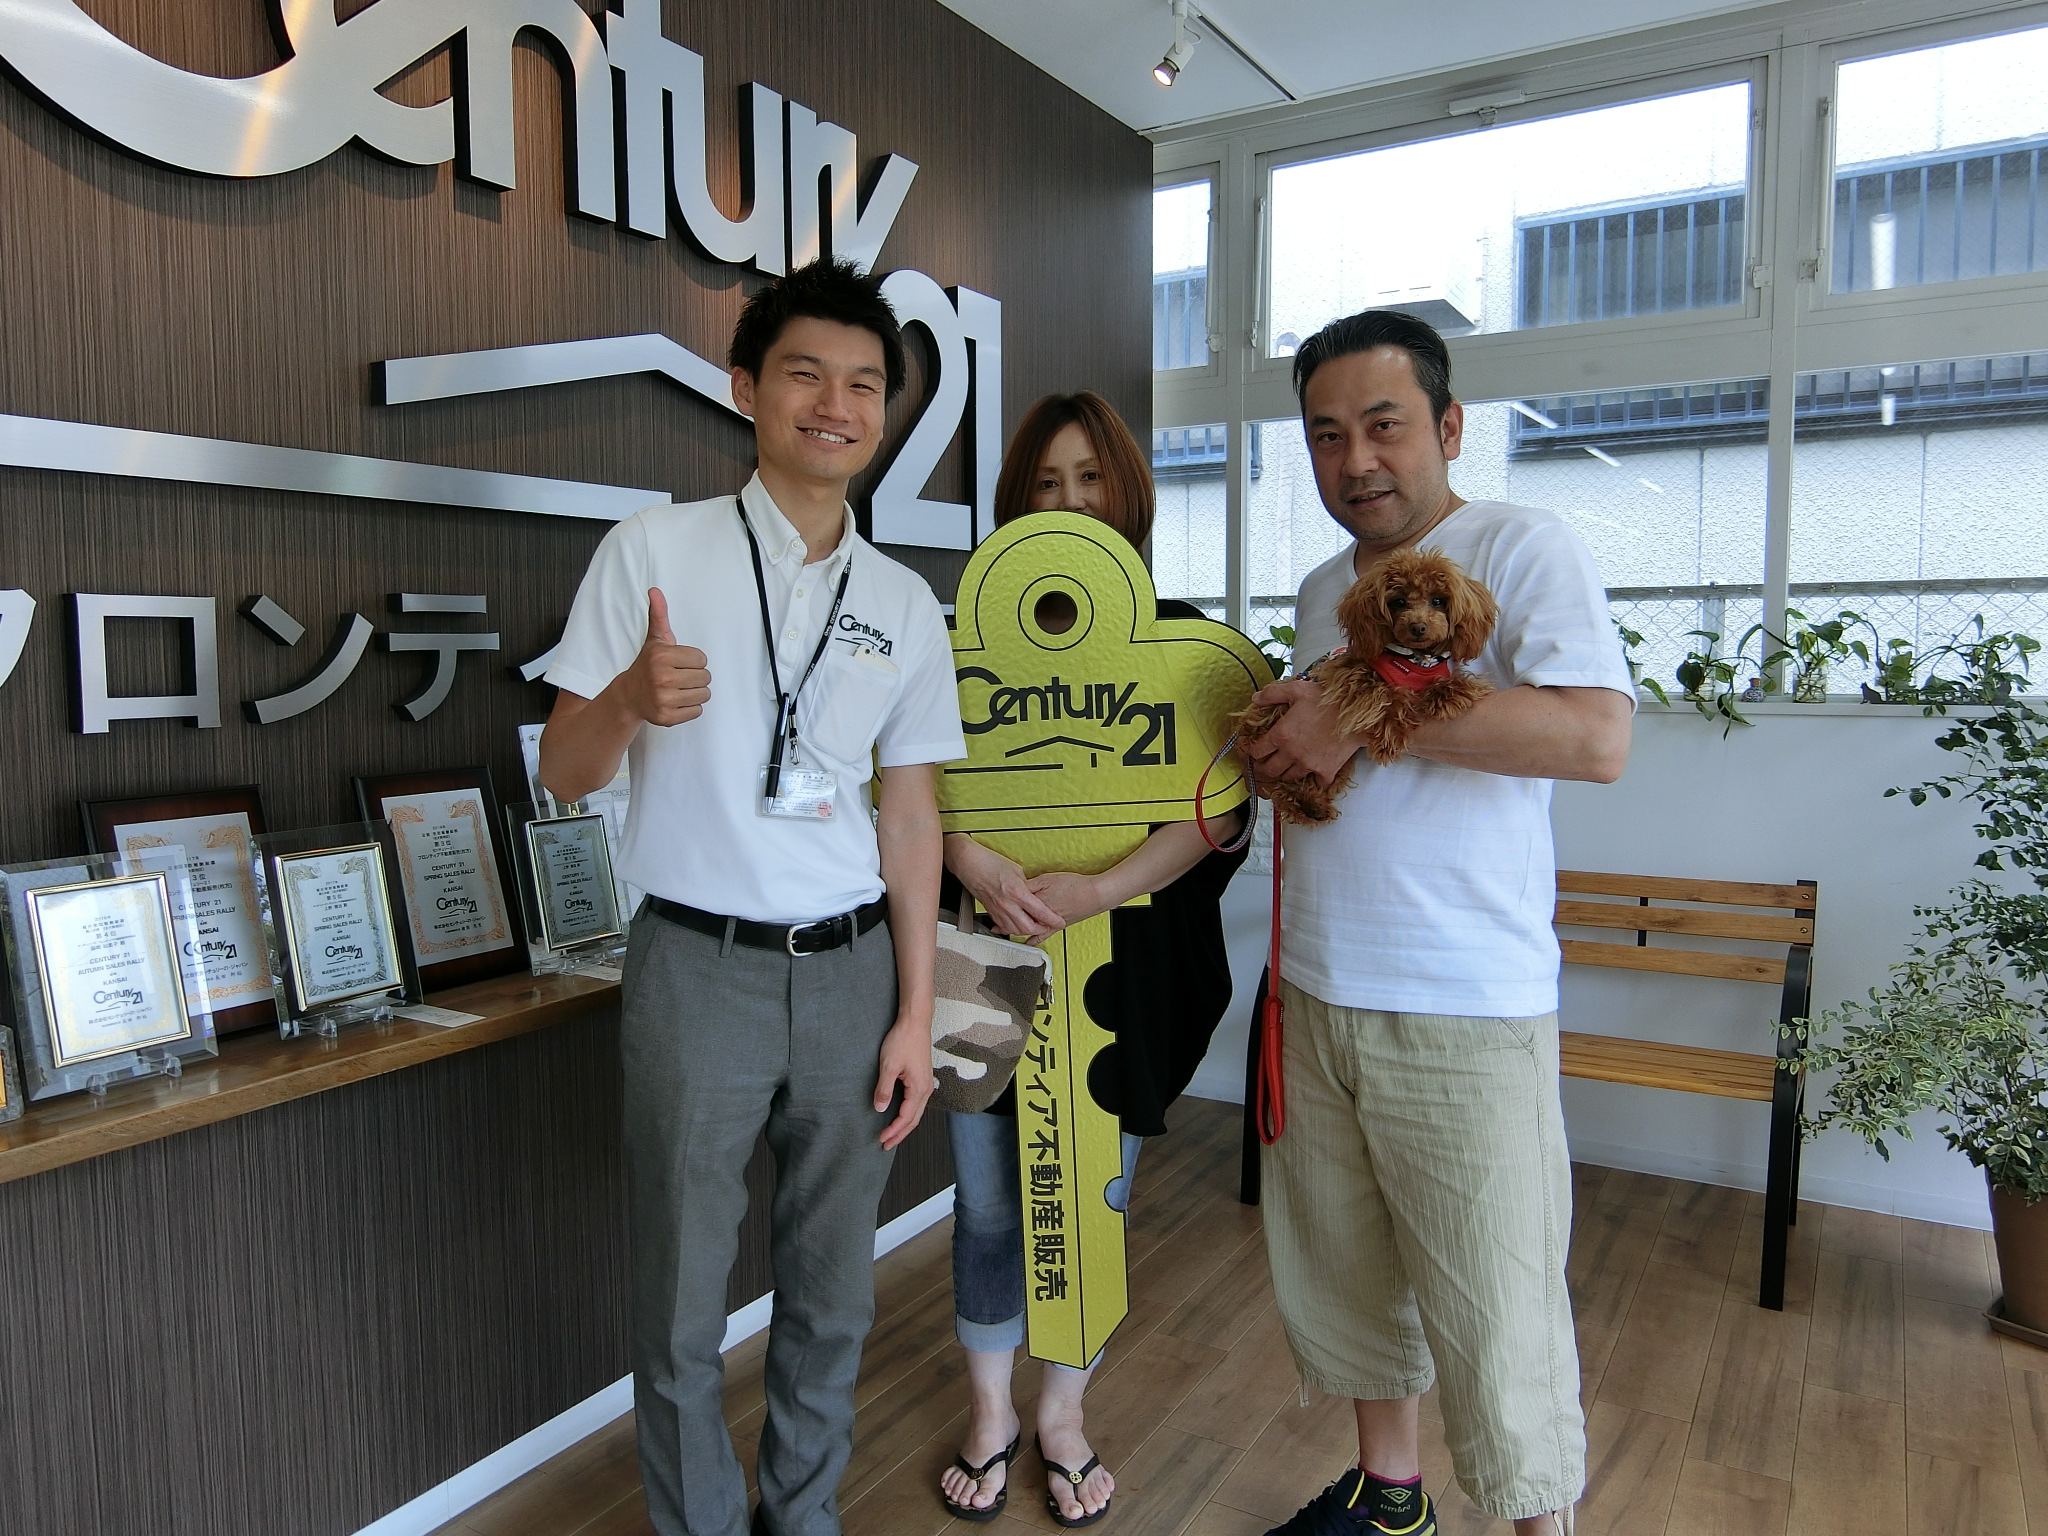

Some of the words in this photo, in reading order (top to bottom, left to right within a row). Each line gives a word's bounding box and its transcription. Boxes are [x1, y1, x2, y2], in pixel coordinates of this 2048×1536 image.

[871, 269, 1000, 550] 21
[839, 614, 884, 640] Century
[878, 638, 893, 656] 21
[956, 666, 1138, 734] Century
[1119, 702, 1177, 766] 21
[431, 863, 456, 871] CENTURY
[443, 885, 463, 893] KANSAI
[436, 897, 469, 910] Century
[467, 900, 478, 913] 21
[565, 899, 588, 909] Century
[586, 901, 593, 911] 21
[196, 910, 216, 918] SALES
[217, 906, 236, 915] RALLY
[322, 914, 345, 922] CENTURY
[199, 927, 219, 935] ANSAI
[224, 944, 238, 959] 21
[325, 945, 355, 957] Century
[354, 947, 363, 959] 21
[90, 954, 120, 964] CENTURY
[78, 965, 104, 975] AUTUMN
[105, 961, 125, 969] SALES
[127, 957, 145, 965] RALLY
[103, 977, 128, 986] KANSAI
[93, 988, 133, 1004] Century
[131, 991, 143, 1004] 21
